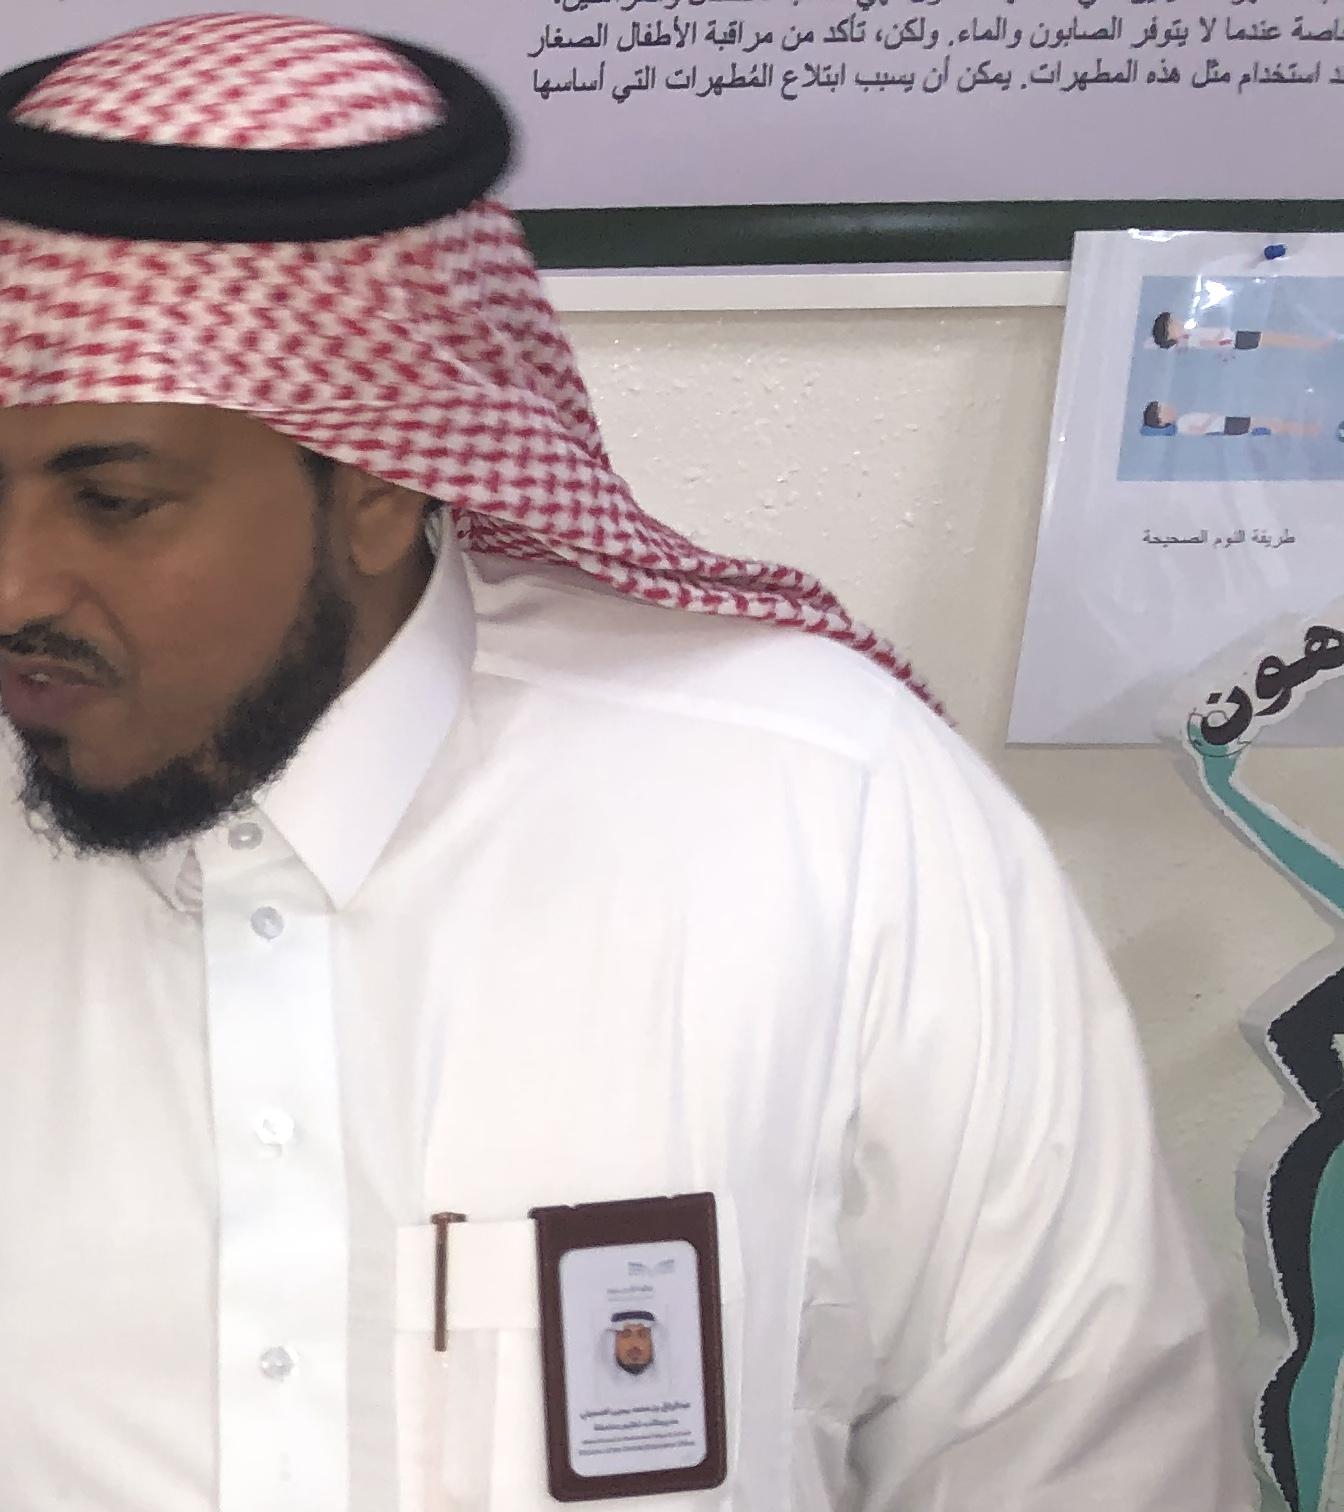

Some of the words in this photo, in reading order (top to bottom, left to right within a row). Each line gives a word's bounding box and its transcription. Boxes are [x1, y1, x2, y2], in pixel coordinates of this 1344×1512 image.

[527, 22, 608, 57] الصغار
[617, 16, 697, 53] الأطفال
[704, 19, 773, 54] مراقبة
[782, 26, 814, 53] من
[823, 13, 866, 43] تأكد
[876, 18, 939, 49] ولكن،
[948, 17, 1020, 48] والماء.
[1029, 16, 1122, 47] الصابون
[1130, 15, 1190, 48] يتوفر
[1199, 17, 1216, 42] لا
[1226, 17, 1282, 41] عندما
[1291, 16, 1344, 41] اصة
[532, 61, 606, 101] أساسها
[612, 64, 656, 103] التي
[781, 62, 846, 101] ابتلاع
[854, 70, 914, 93] يسبب
[922, 54, 950, 92] أن
[956, 60, 1012, 92] يمكن
[1020, 58, 1138, 92] المطهرات.
[1146, 58, 1181, 85] هذه
[1191, 58, 1231, 89] مثل
[1238, 60, 1321, 95] استخدام
[1142, 529, 1208, 548] الصحيحة
[1211, 529, 1246, 548] النوم
[1251, 527, 1296, 548] طريقة
